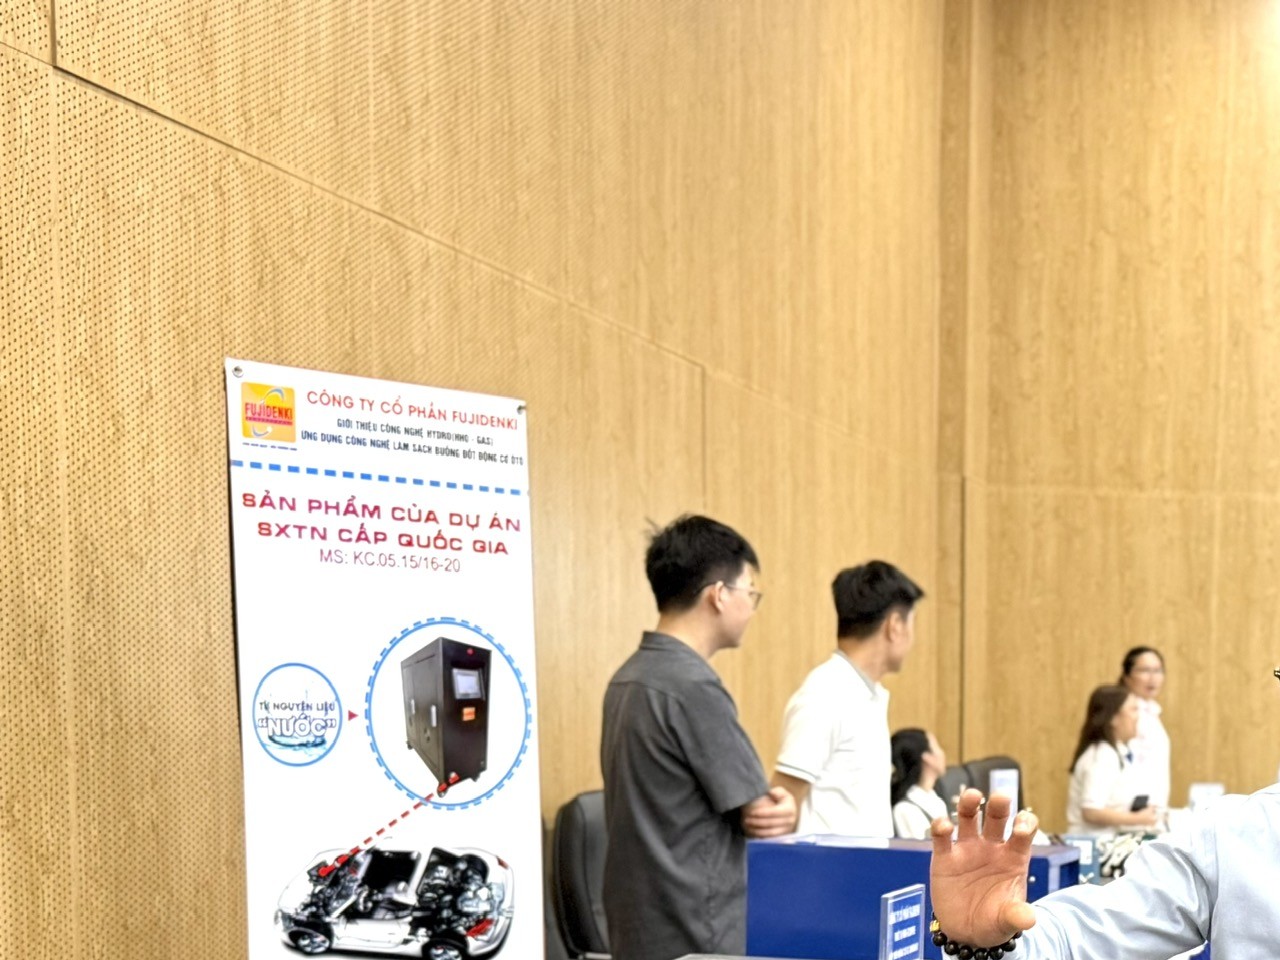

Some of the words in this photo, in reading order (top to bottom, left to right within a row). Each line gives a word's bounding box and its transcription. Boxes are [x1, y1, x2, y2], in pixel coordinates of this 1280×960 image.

[245, 402, 293, 420] FUJIDENKI
[306, 389, 354, 409] CÔNG
[359, 398, 375, 412] TY
[380, 395, 403, 415] CỔ
[408, 401, 447, 421] PHẦN
[452, 410, 518, 430] FUJIDENKI
[345, 435, 367, 447] CÔNG
[380, 423, 401, 435] CÔNG
[242, 489, 296, 512] SẢN
[308, 494, 381, 520] PHẨM
[391, 502, 440, 525] CỦA
[449, 512, 480, 531] DỰ
[489, 512, 520, 532] ÁN
[258, 521, 328, 541] SXTN
[338, 522, 388, 544] CẤP
[398, 529, 463, 551] QUỐC
[472, 539, 509, 555] GIA
[320, 548, 348, 564] MS:
[353, 550, 461, 573] KC.05.15/16-20
